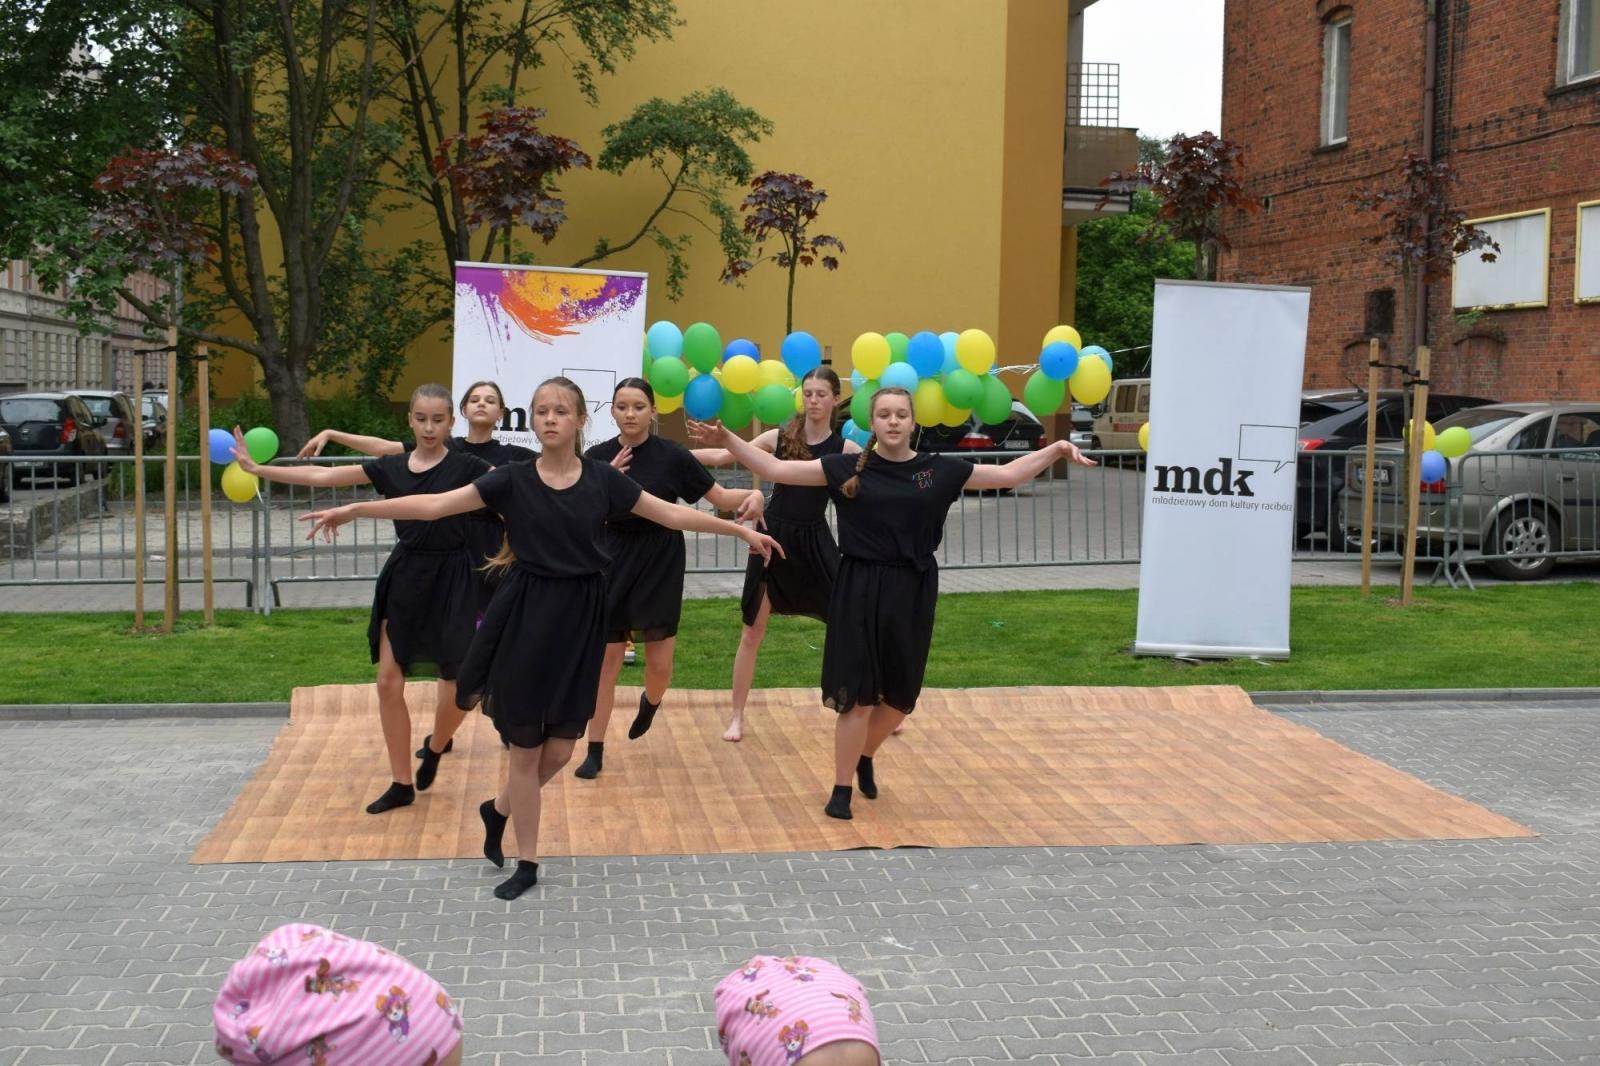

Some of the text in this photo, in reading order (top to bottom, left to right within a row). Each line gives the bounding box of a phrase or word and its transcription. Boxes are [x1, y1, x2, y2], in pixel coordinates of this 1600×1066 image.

[1153, 457, 1254, 497] mdk
[1208, 499, 1228, 508] dom
[1230, 499, 1259, 511] kultury
